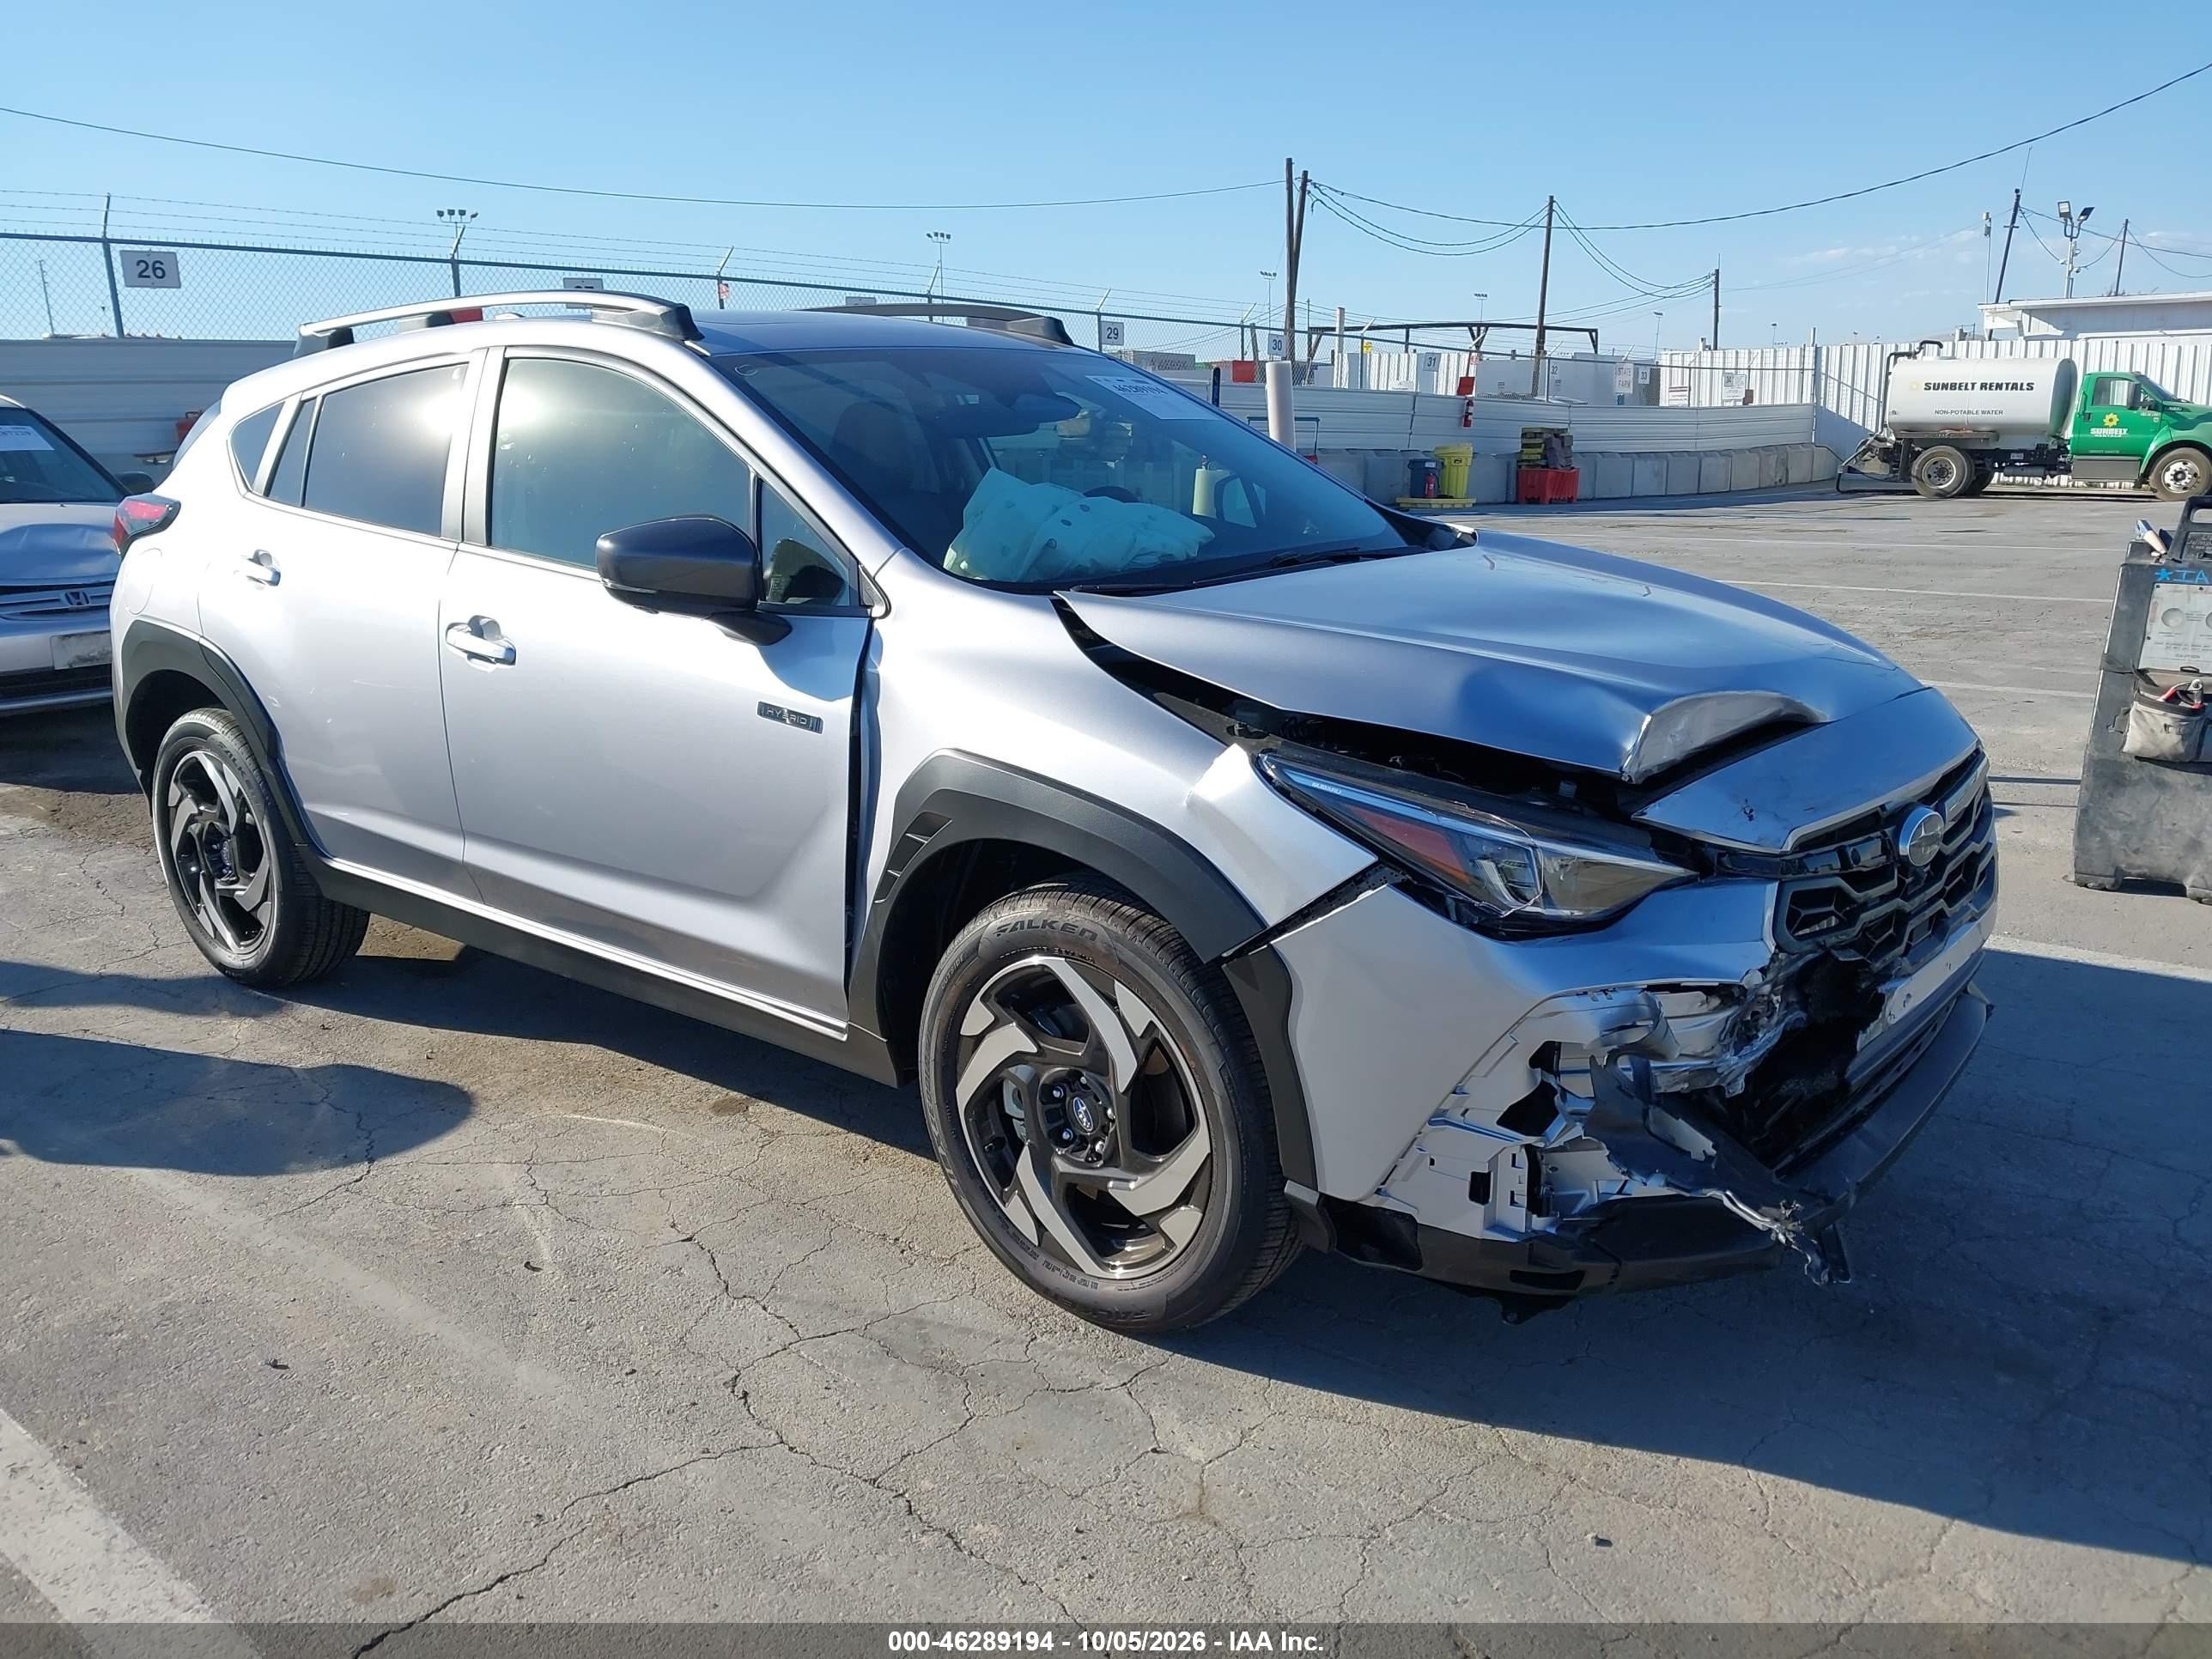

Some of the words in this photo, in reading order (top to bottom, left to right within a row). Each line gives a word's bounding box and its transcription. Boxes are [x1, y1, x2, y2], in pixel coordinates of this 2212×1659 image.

[136, 259, 166, 279] 26
[1106, 326, 1119, 340] 29
[1272, 339, 1283, 351] 30
[1427, 356, 1437, 368] 31
[1923, 381, 1977, 392] SUNBELT
[1979, 381, 2035, 392] RENTALS
[767, 707, 807, 726] HYBRID
[994, 919, 1099, 942] FALKEN
